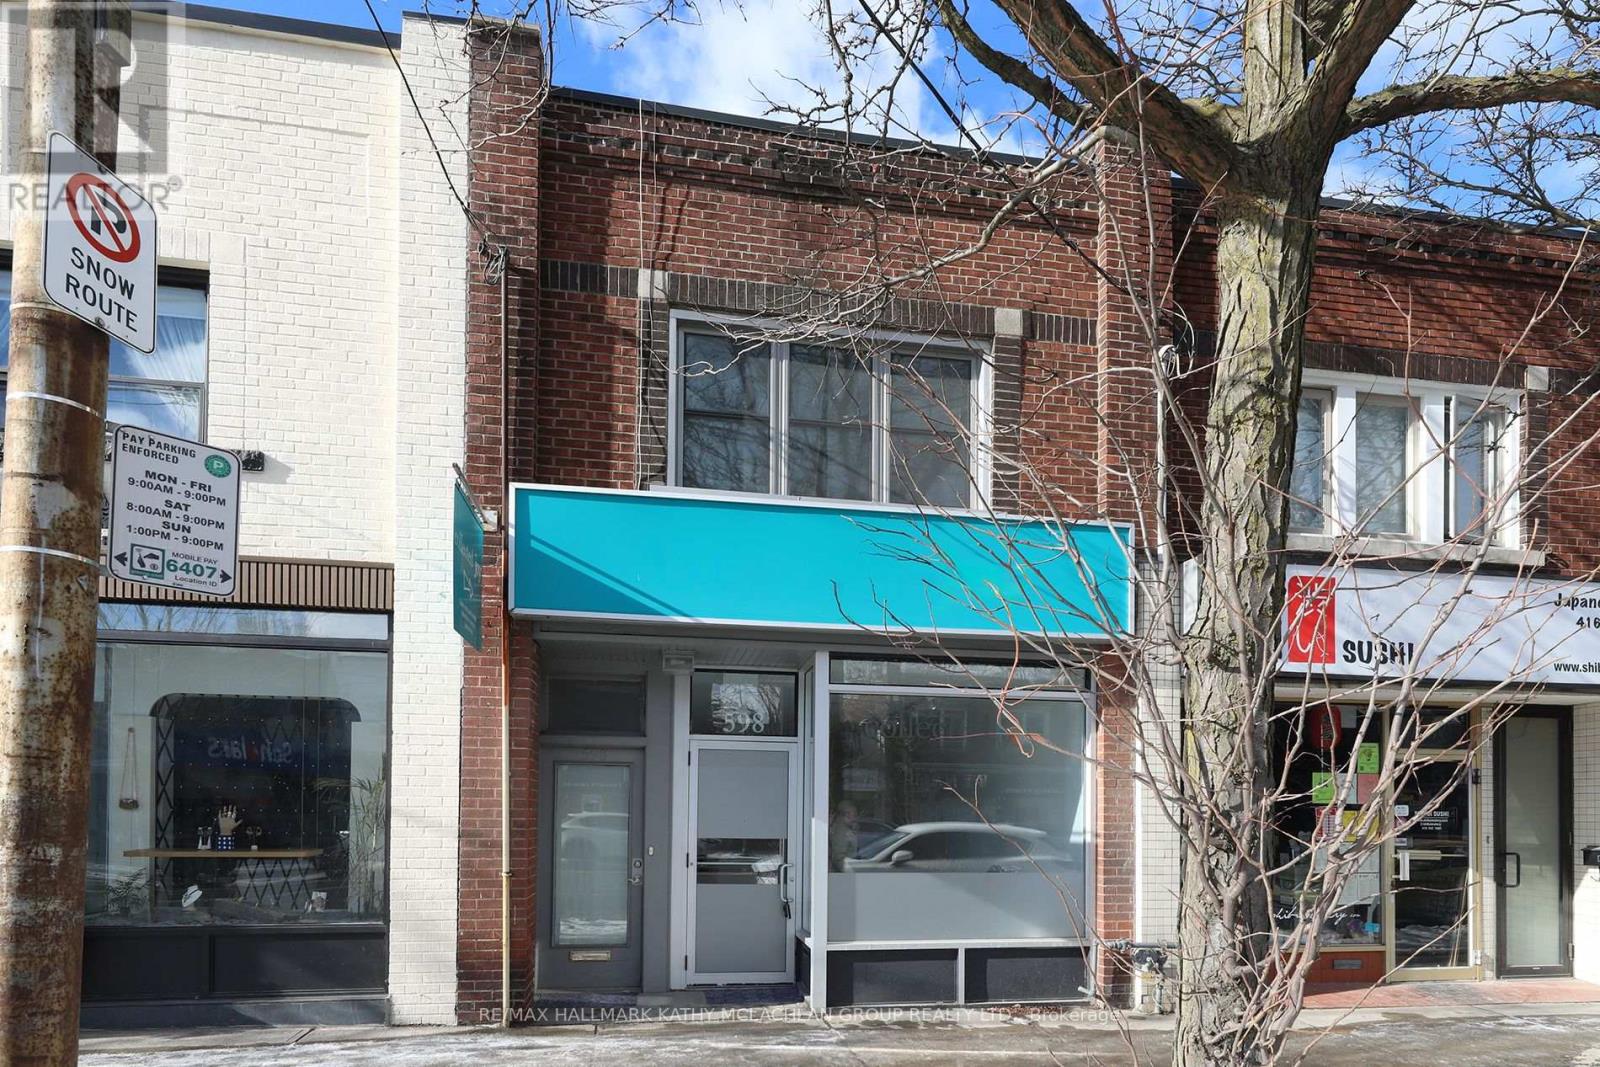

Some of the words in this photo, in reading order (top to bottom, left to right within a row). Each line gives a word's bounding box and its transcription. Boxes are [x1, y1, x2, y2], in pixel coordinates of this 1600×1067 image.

[71, 246, 135, 300] SNOW
[65, 274, 138, 333] ROUTE
[122, 432, 144, 445] PAY
[148, 437, 197, 458] PARKING
[122, 443, 179, 464] ENFORCED
[127, 477, 173, 495] 9:00AM
[184, 490, 226, 506] 9:00PM
[145, 470, 177, 485] MON
[190, 480, 212, 493] FRI
[126, 502, 172, 519] 8:00AM
[182, 514, 225, 530] 9:00PM
[164, 499, 191, 512] SAT
[126, 525, 170, 541] 1:00PM
[181, 536, 224, 551] 9:00PM
[162, 521, 191, 534] SUN
[166, 559, 217, 580] 6407
[171, 552, 202, 563] MOBILE
[203, 556, 218, 565] PAY
[174, 575, 206, 585] Location
[1343, 639, 1414, 666] SUSHI
[723, 713, 764, 734] 598
